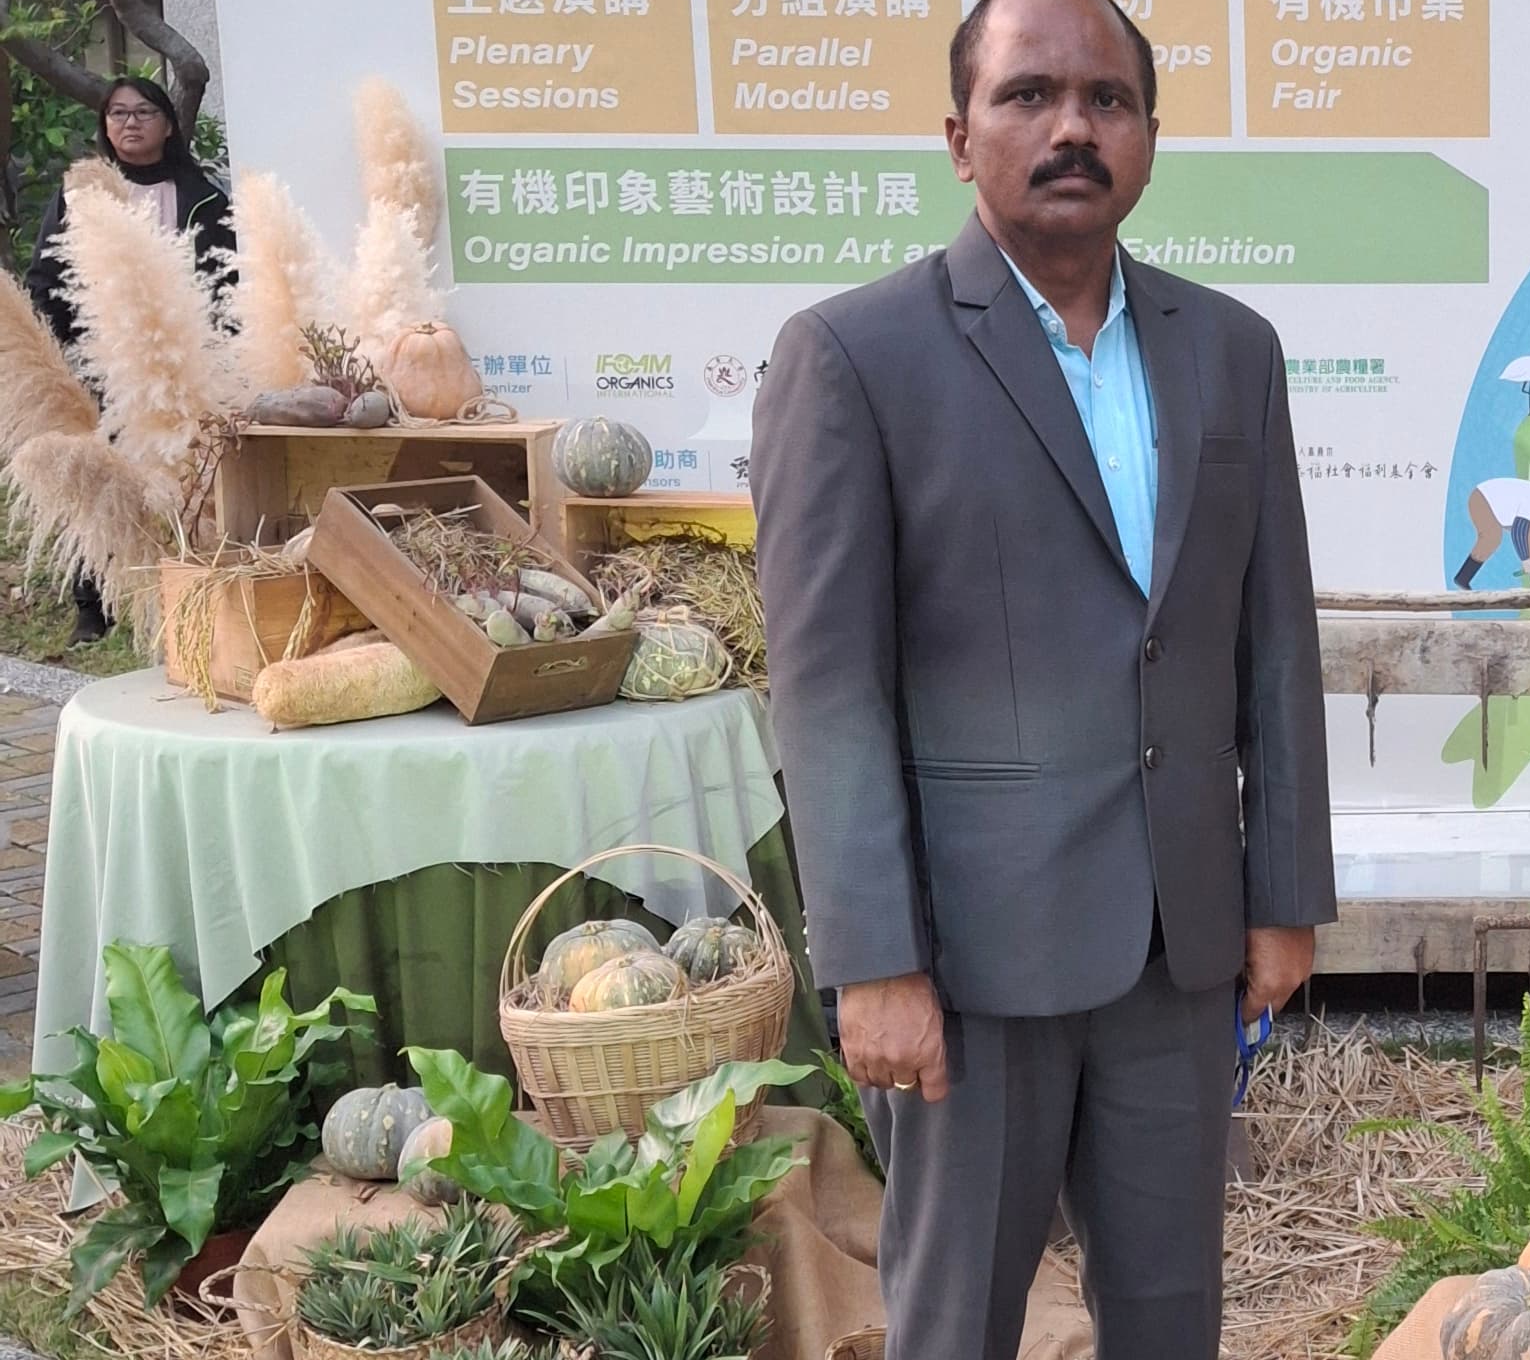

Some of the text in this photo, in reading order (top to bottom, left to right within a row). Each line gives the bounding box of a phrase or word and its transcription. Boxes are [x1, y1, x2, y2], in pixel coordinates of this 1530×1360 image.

[450, 36, 594, 72] Plenary
[732, 38, 872, 67] Parallel
[1272, 38, 1412, 73] Organic
[453, 80, 618, 108] Sessions
[735, 82, 890, 111] Modules
[1272, 81, 1341, 109] Fair
[459, 168, 921, 217] 有機印象藝術設計展
[464, 235, 610, 270] Organic
[623, 236, 824, 270] Impression
[835, 237, 894, 264] Art
[1123, 236, 1295, 265] Exhibition
[596, 354, 672, 373] IFOAM
[597, 376, 674, 390] ORGANICS
